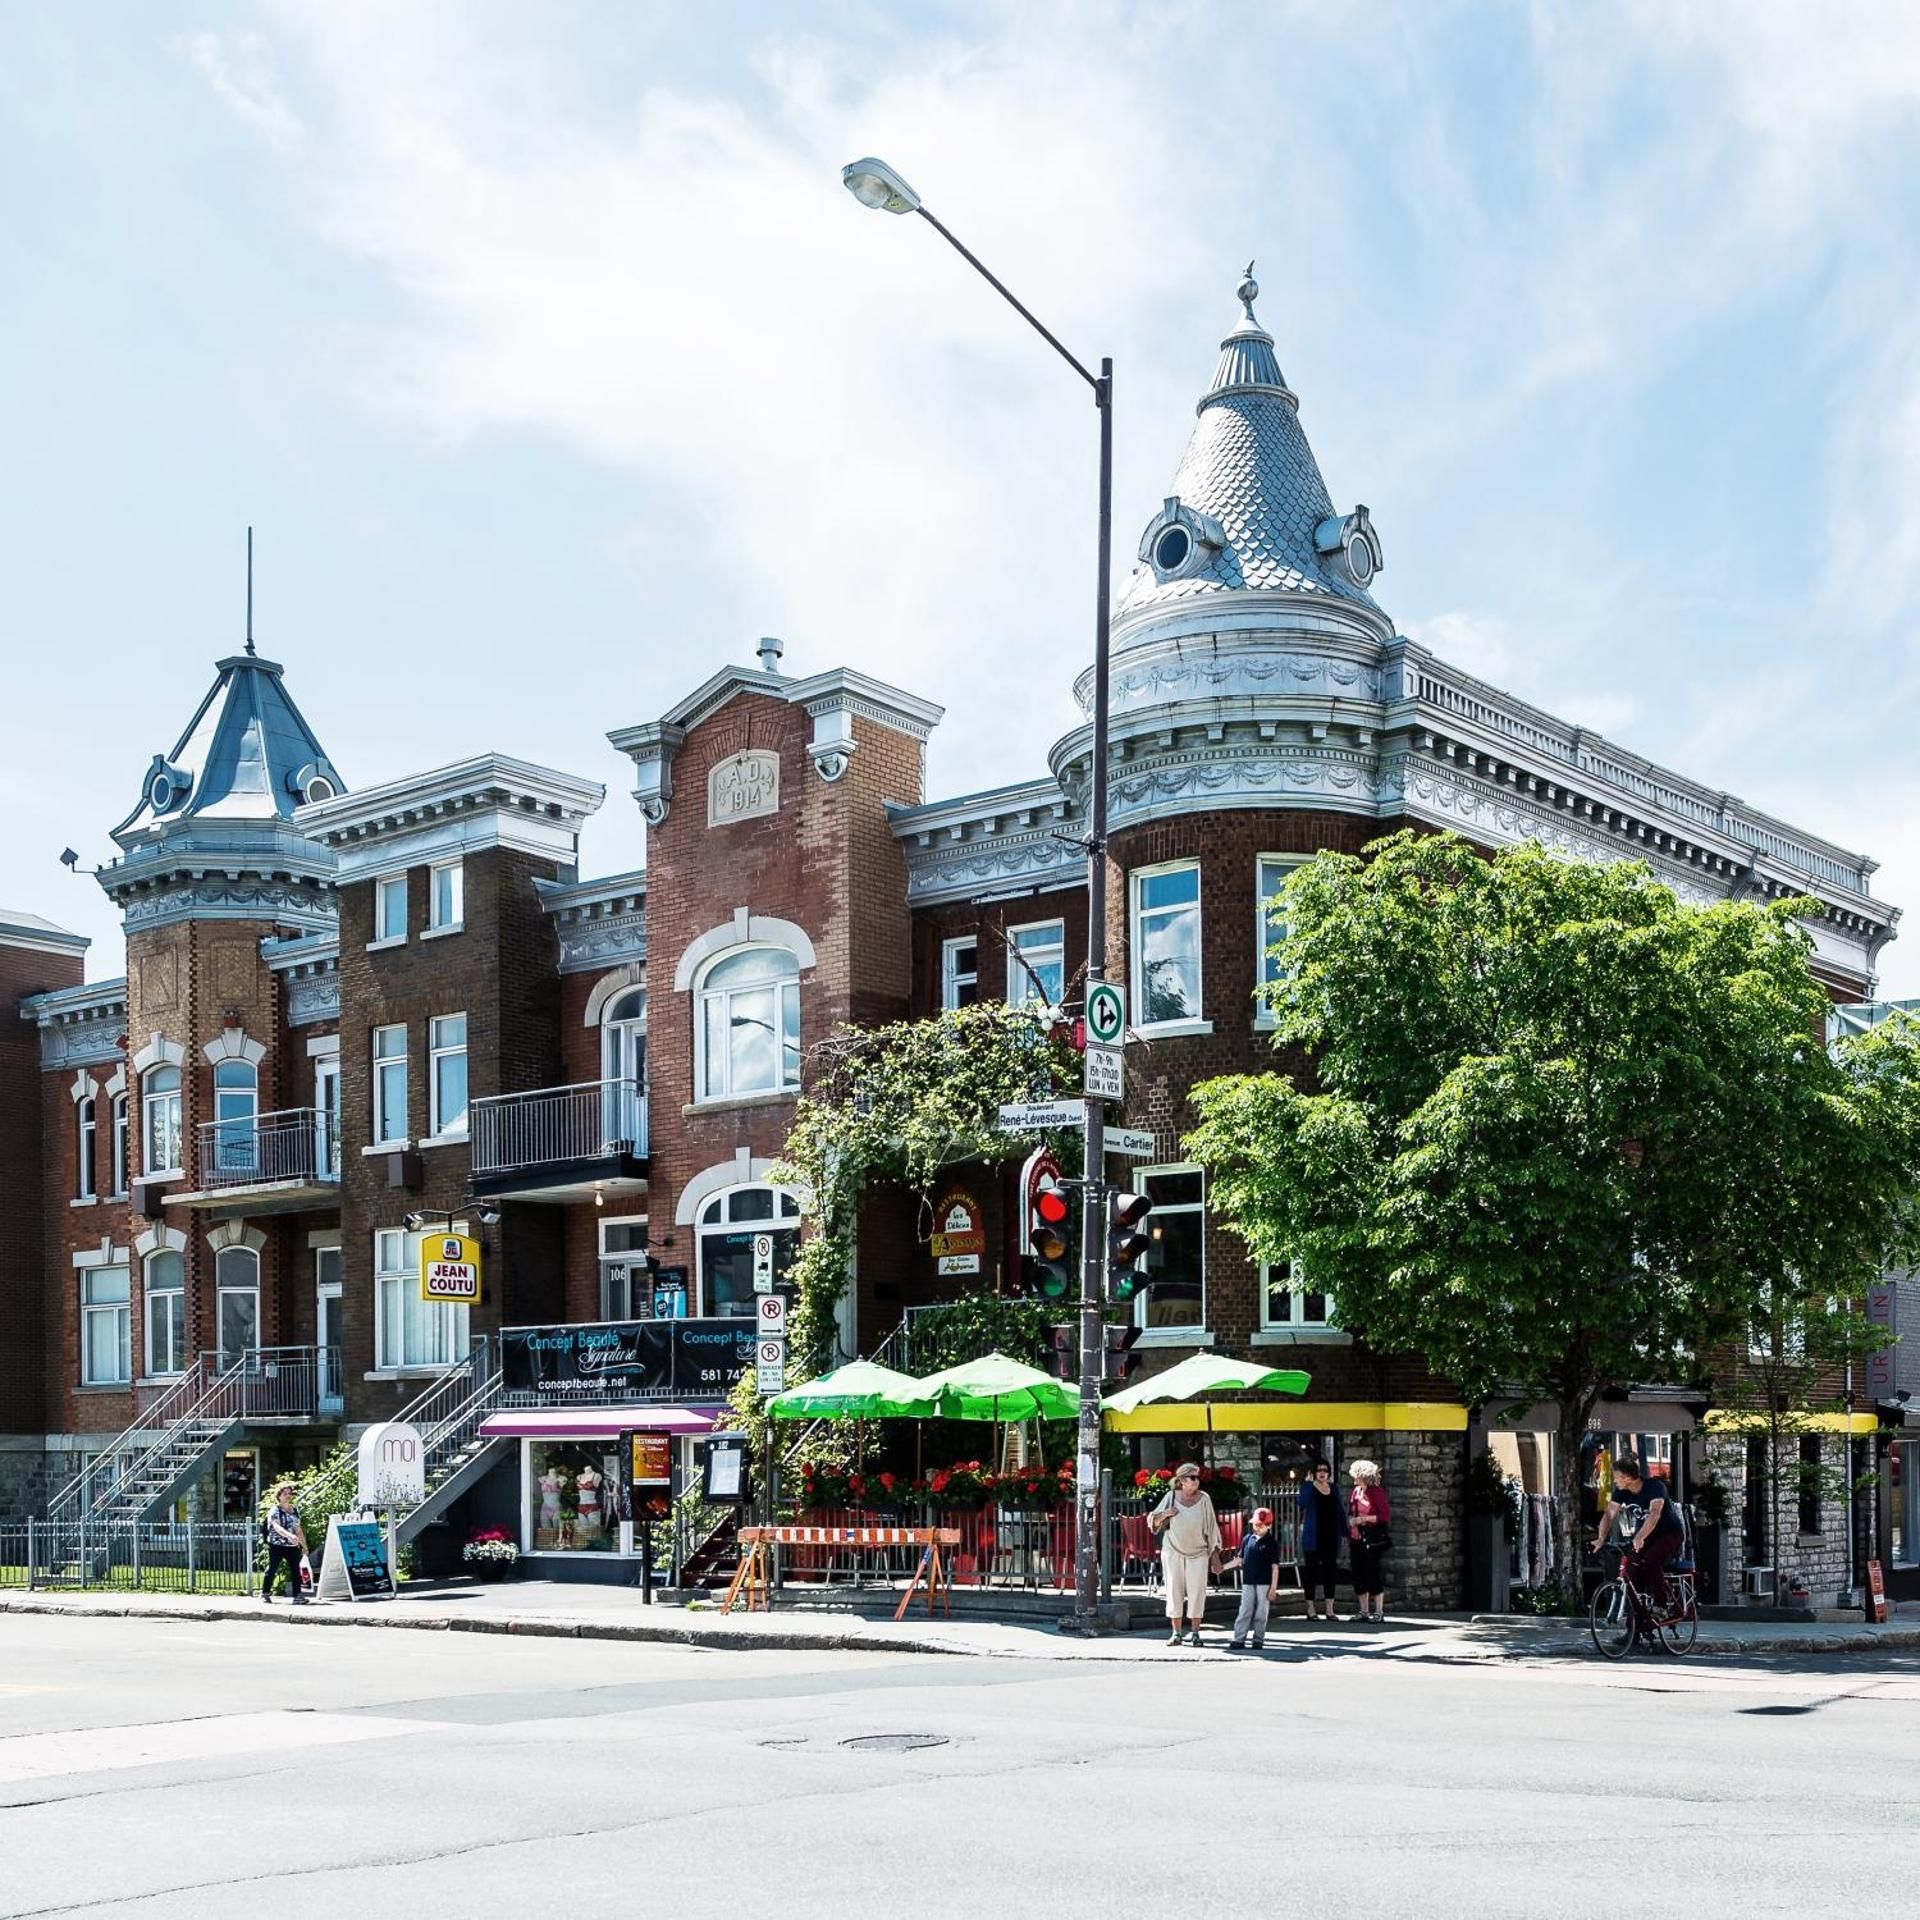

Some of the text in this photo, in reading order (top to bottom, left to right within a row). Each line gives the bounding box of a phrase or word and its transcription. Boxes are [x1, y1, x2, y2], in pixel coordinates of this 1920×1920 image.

[731, 785, 761, 812] 1914
[1088, 1078, 1100, 1090] LUN
[1107, 1081, 1119, 1093] VEN
[1026, 1103, 1054, 1112] Boulevard
[1000, 1113, 1067, 1126] René-Lévesque
[1123, 1135, 1153, 1150] Cartier
[434, 1264, 468, 1278] JEAN
[610, 1267, 626, 1281] 106
[430, 1278, 473, 1292] COUTU
[527, 1328, 620, 1354] Concept Beauté
[682, 1330, 758, 1346] Concept Bea
[1873, 1294, 1889, 1385] URIN
[578, 1343, 638, 1373] Signature
[700, 1369, 721, 1381] 581
